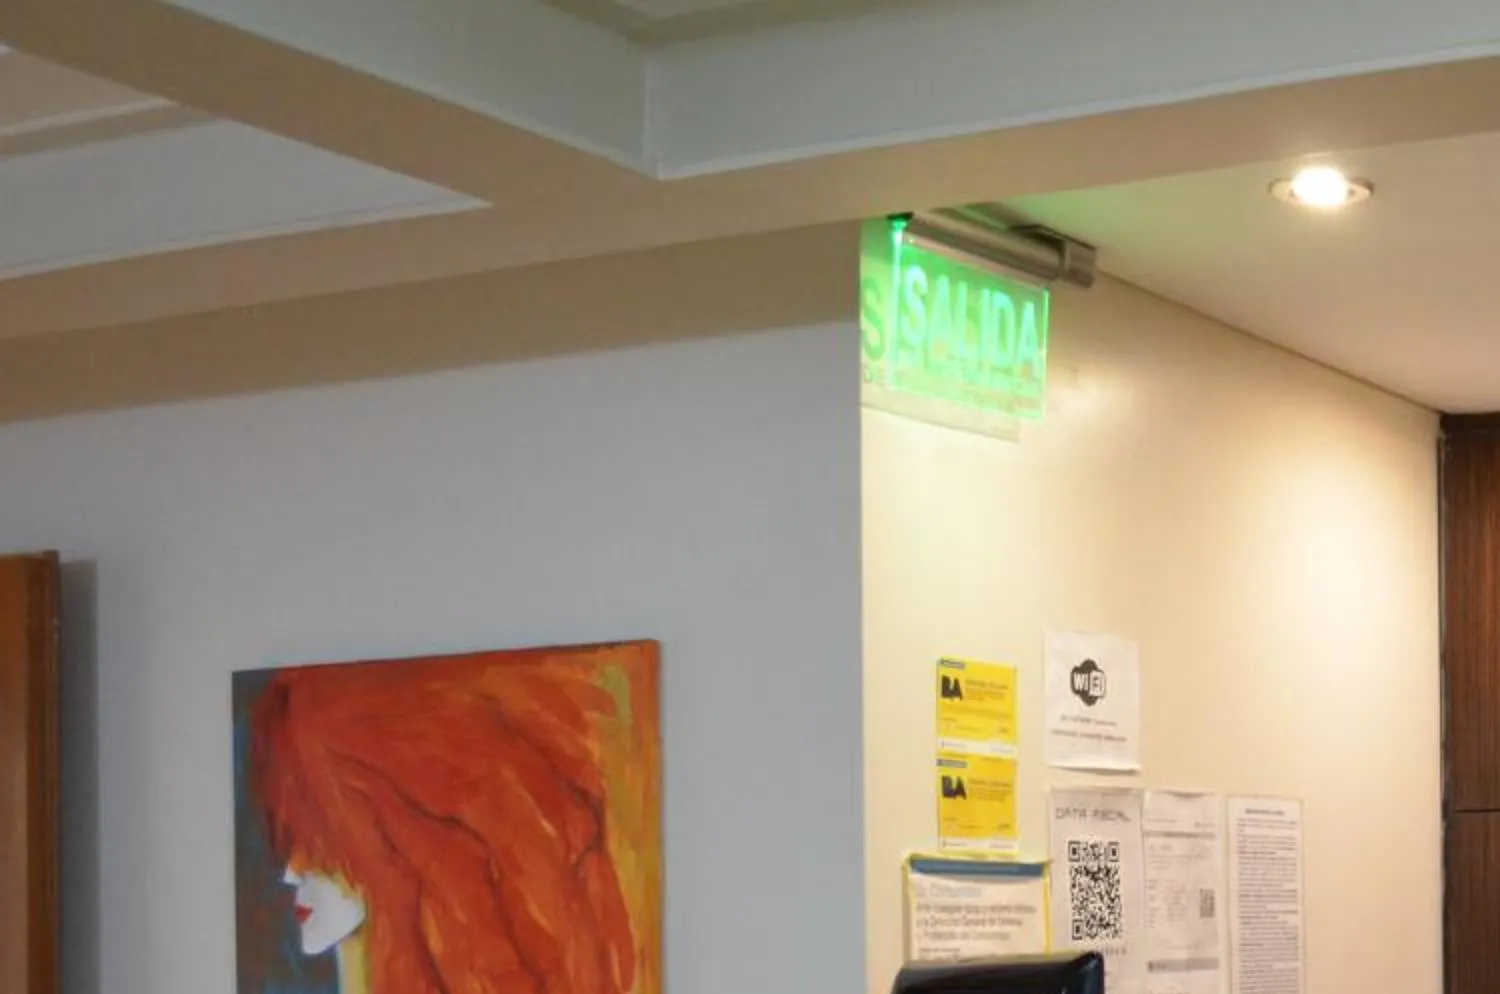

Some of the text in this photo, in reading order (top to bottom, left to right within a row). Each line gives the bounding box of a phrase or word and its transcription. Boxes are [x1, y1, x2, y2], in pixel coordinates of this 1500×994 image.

[901, 264, 1042, 382] SALIDA
[941, 675, 963, 700] BA
[942, 775, 967, 800] BA
